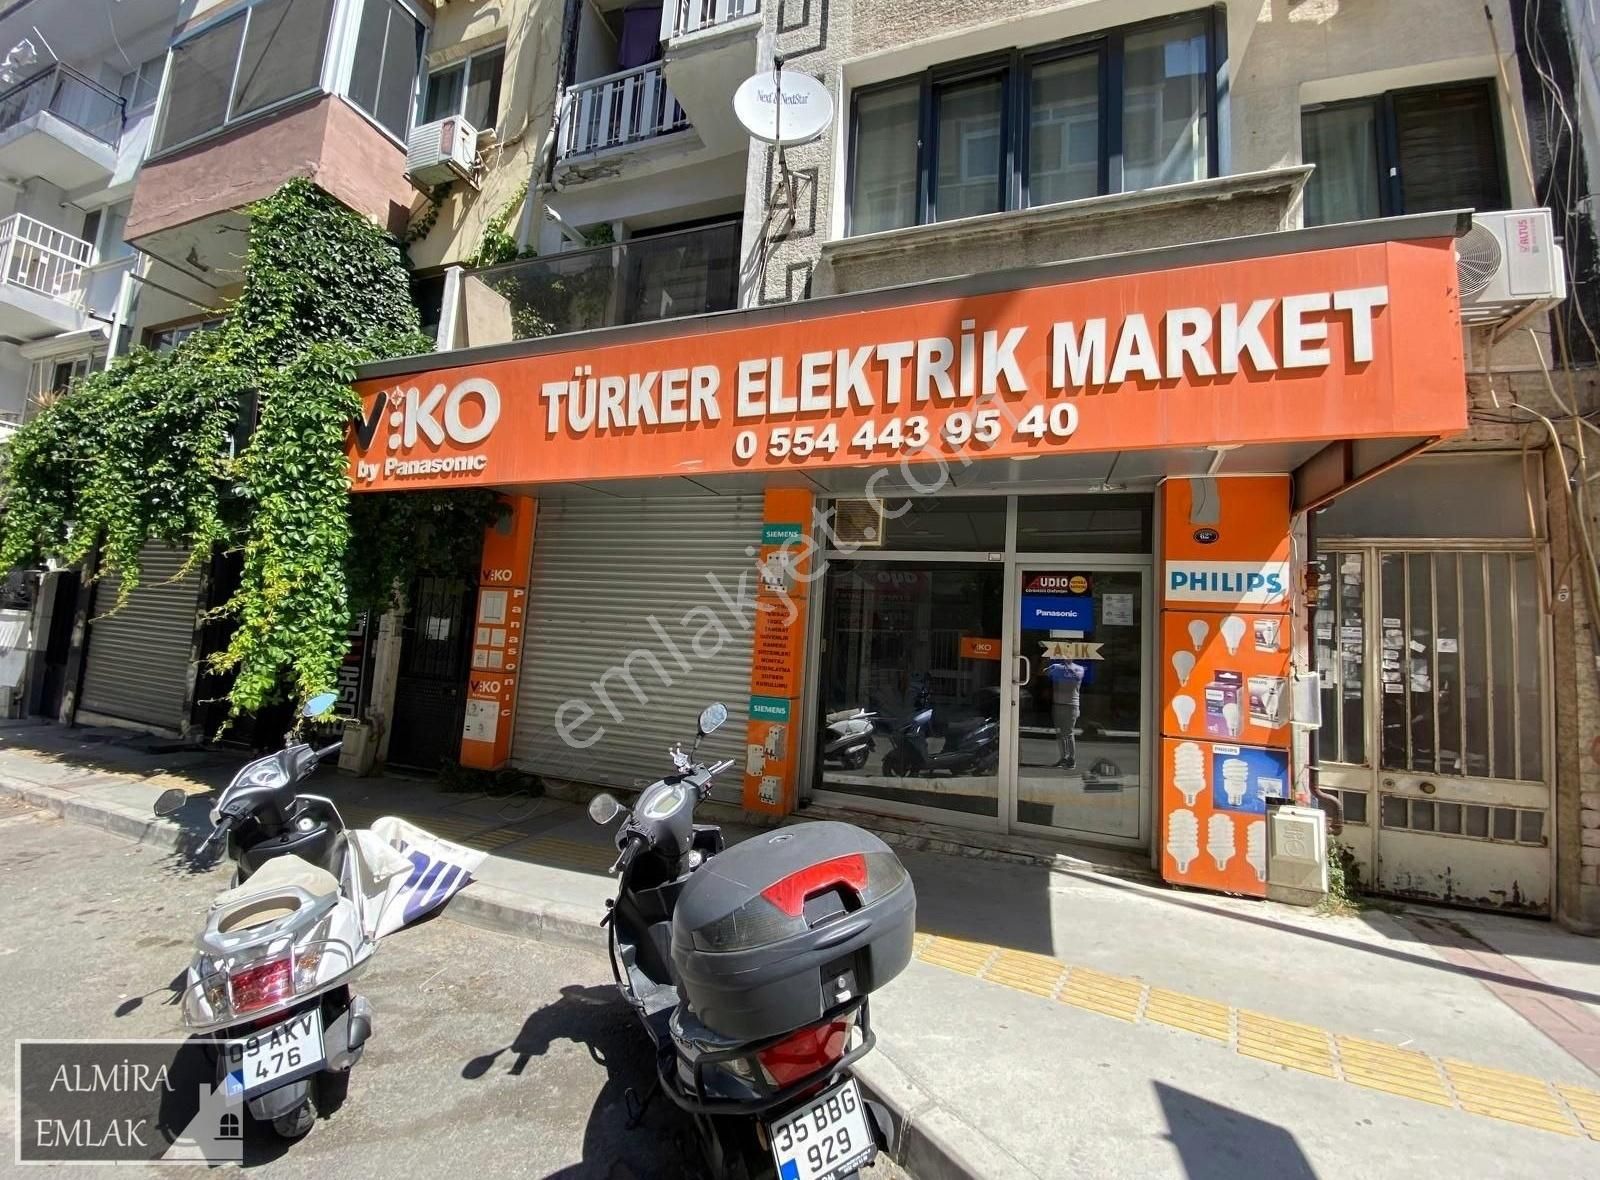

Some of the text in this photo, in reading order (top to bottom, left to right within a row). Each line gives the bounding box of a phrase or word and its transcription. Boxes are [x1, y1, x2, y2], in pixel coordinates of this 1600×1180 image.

[1518, 219, 1529, 246] ALTUS
[541, 285, 1389, 433] TÜRKER ELEKTRİK MARKET
[735, 402, 1079, 459] 0 554 443 95 40
[357, 454, 488, 482] by Panasonic
[766, 530, 798, 538] SIEMENS
[1028, 577, 1068, 588] AUDIO
[1171, 571, 1283, 594] PHILIPS
[1036, 609, 1078, 617] Panasonic
[753, 705, 786, 714] SIEMENS
[229, 1015, 312, 1063] 09 AKV
[256, 1047, 301, 1078] 476
[777, 1088, 856, 1152] 35 BBG
[807, 1127, 852, 1173] 929
